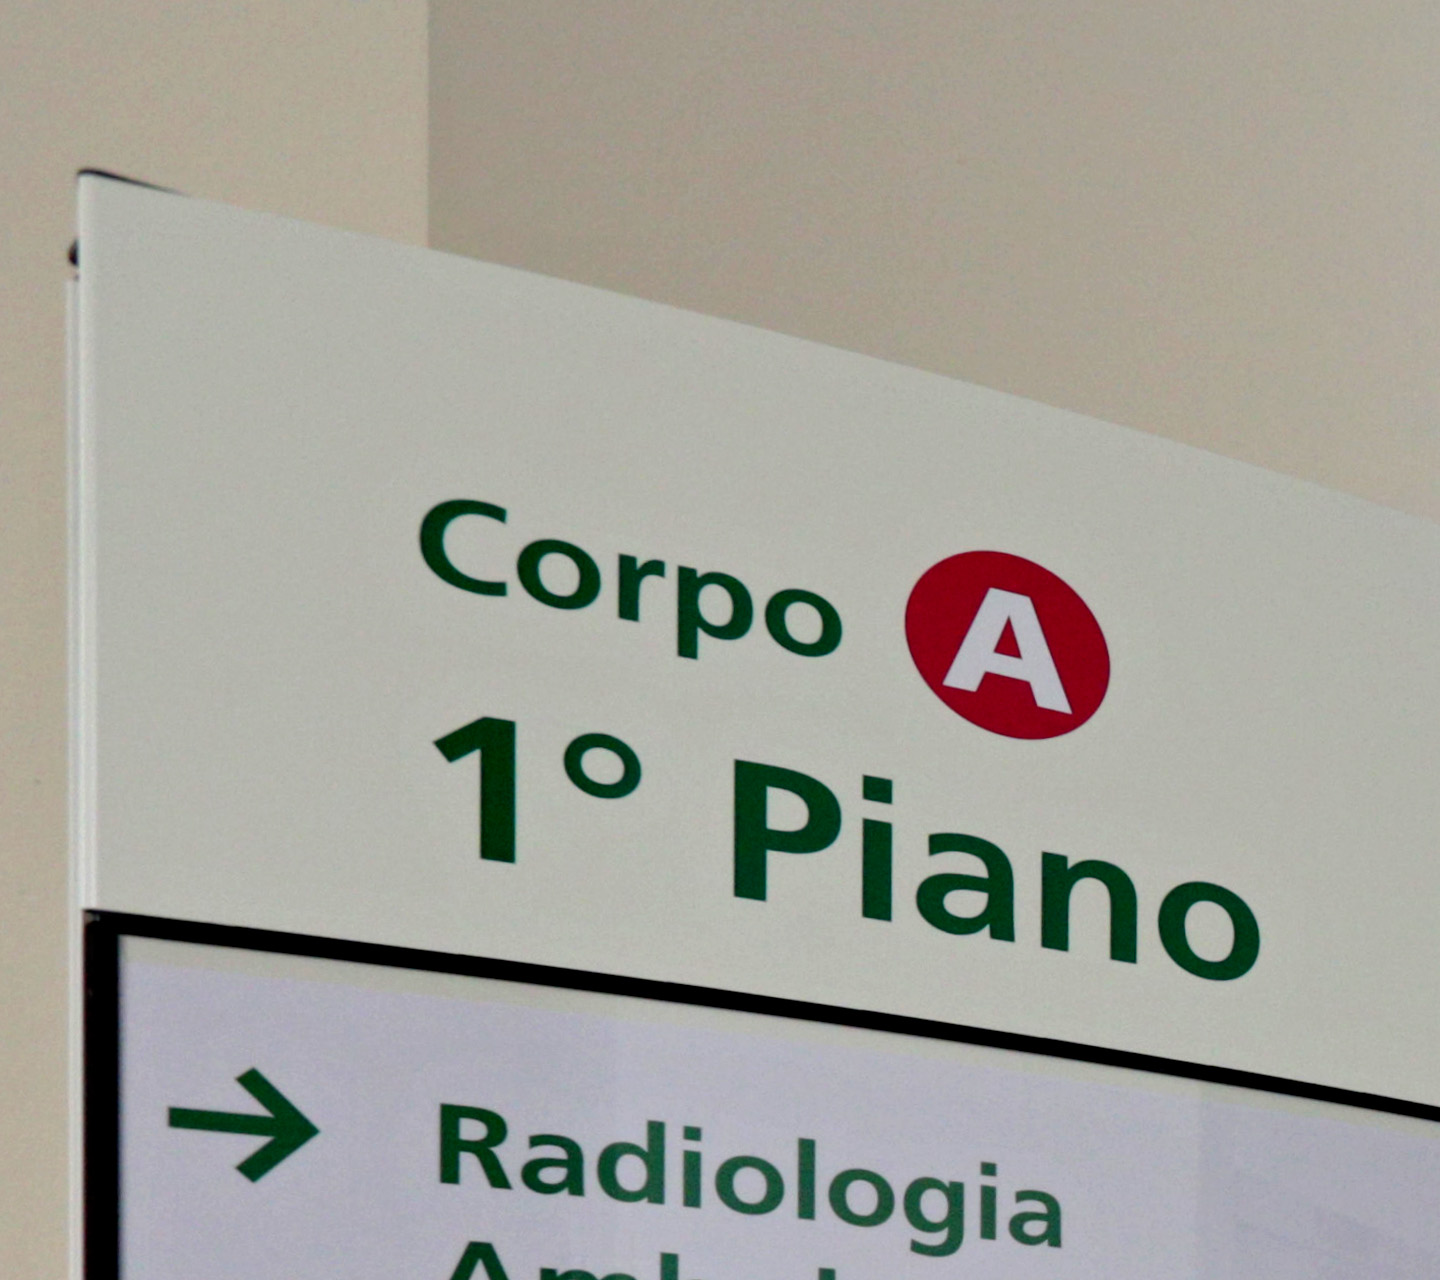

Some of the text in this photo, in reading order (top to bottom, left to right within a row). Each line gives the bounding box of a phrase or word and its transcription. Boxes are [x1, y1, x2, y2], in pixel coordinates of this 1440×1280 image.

[418, 497, 1073, 716] Corpo A
[732, 757, 1262, 982] Piano
[438, 1102, 1064, 1258] Radiologia
